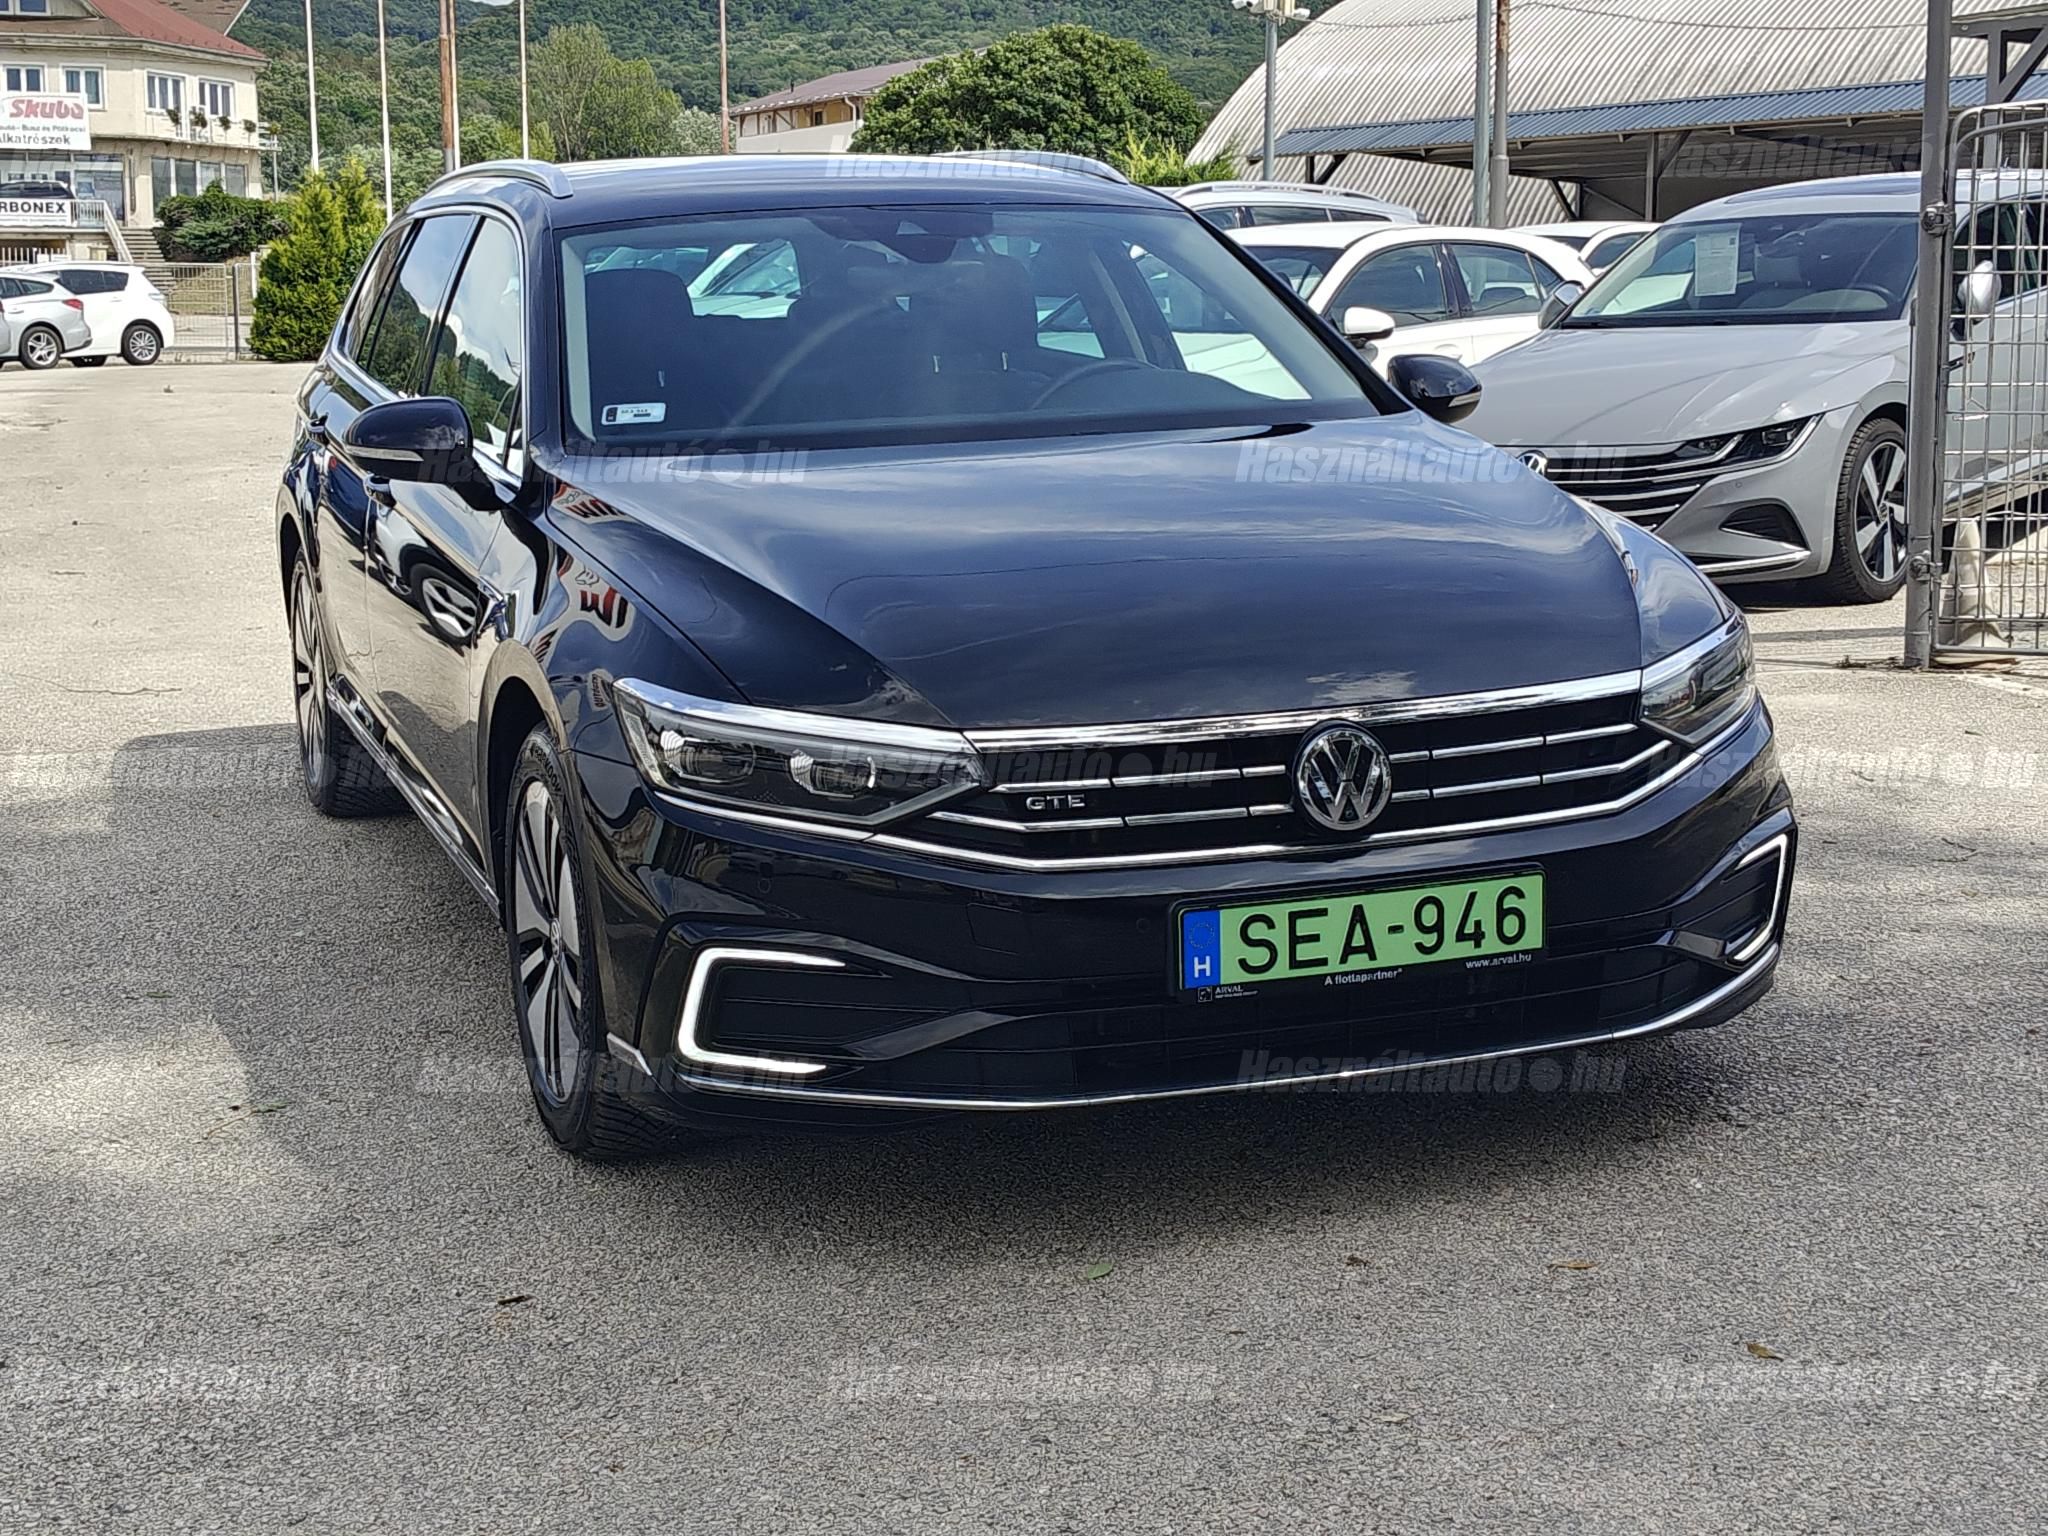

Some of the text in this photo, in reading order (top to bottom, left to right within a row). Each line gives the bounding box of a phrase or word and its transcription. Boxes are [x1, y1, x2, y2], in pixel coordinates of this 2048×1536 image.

[9, 99, 84, 120] Skuba
[0, 133, 71, 146] lkatrészek
[1025, 793, 1086, 811] GTE
[1237, 885, 1527, 975] SEA-946
[1194, 955, 1212, 979] H
[1465, 953, 1532, 969] www.arval.hu
[1215, 984, 1243, 994] ARVAL
[1324, 975, 1333, 986] A
